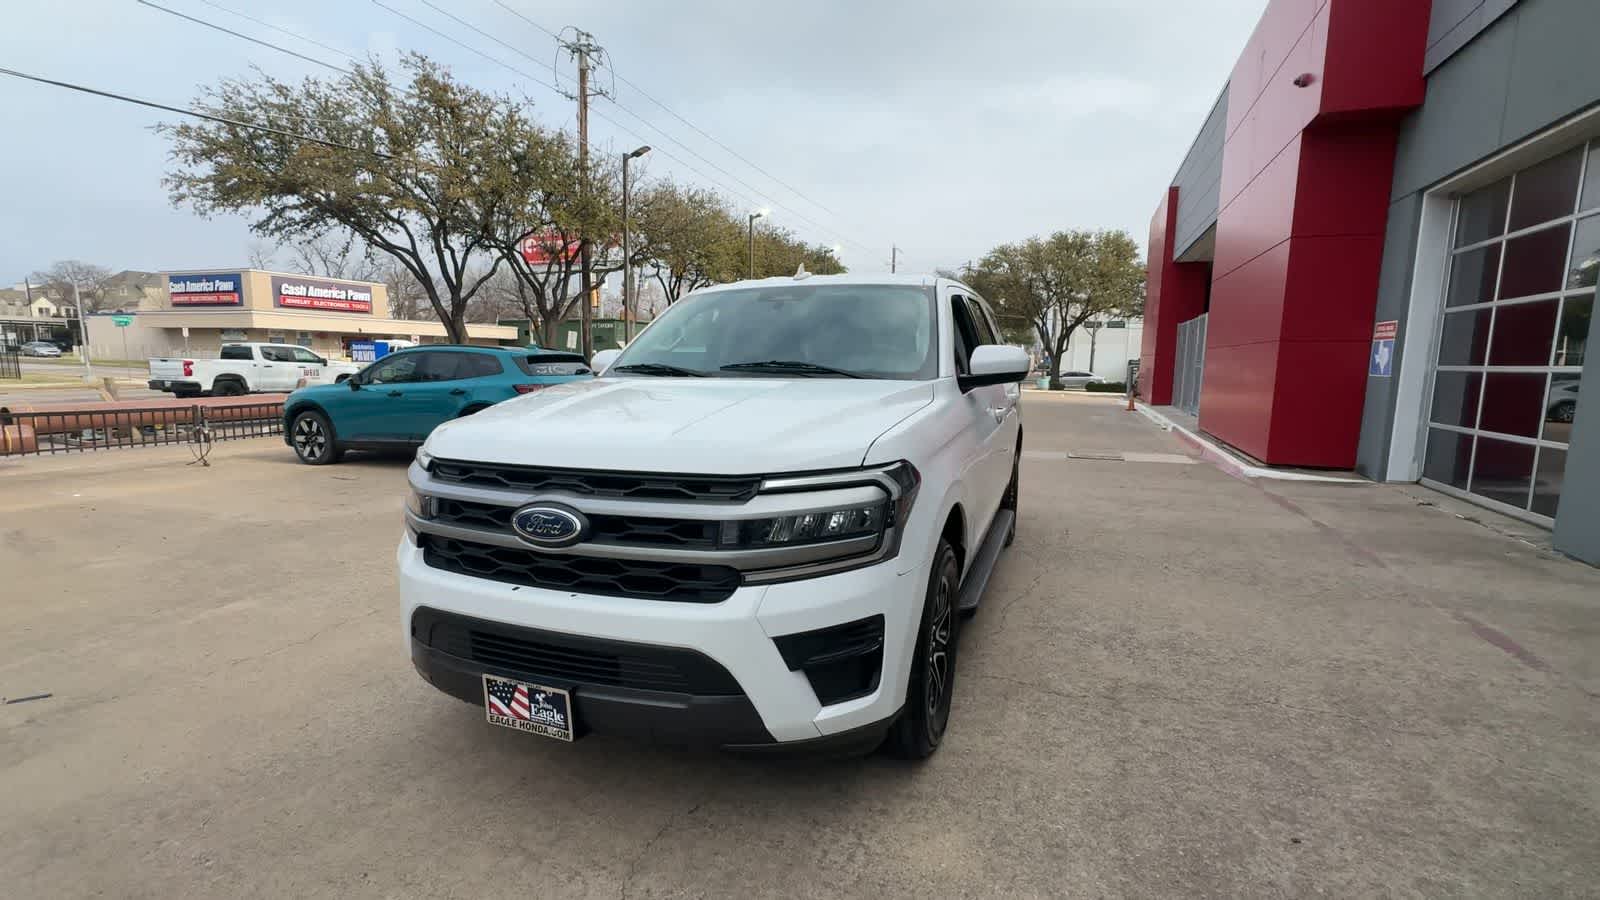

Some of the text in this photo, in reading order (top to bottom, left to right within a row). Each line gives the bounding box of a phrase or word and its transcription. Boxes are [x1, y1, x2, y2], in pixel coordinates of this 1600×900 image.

[169, 280, 234, 293] Cash America Pawn
[281, 283, 370, 302] Cash America Pawn
[313, 300, 351, 308] ELECTRONICS
[352, 350, 376, 361] PAWN
[526, 513, 564, 535] Ford
[539, 701, 553, 710] John
[530, 703, 565, 723] Eagle
[490, 715, 517, 728] EAGLE
